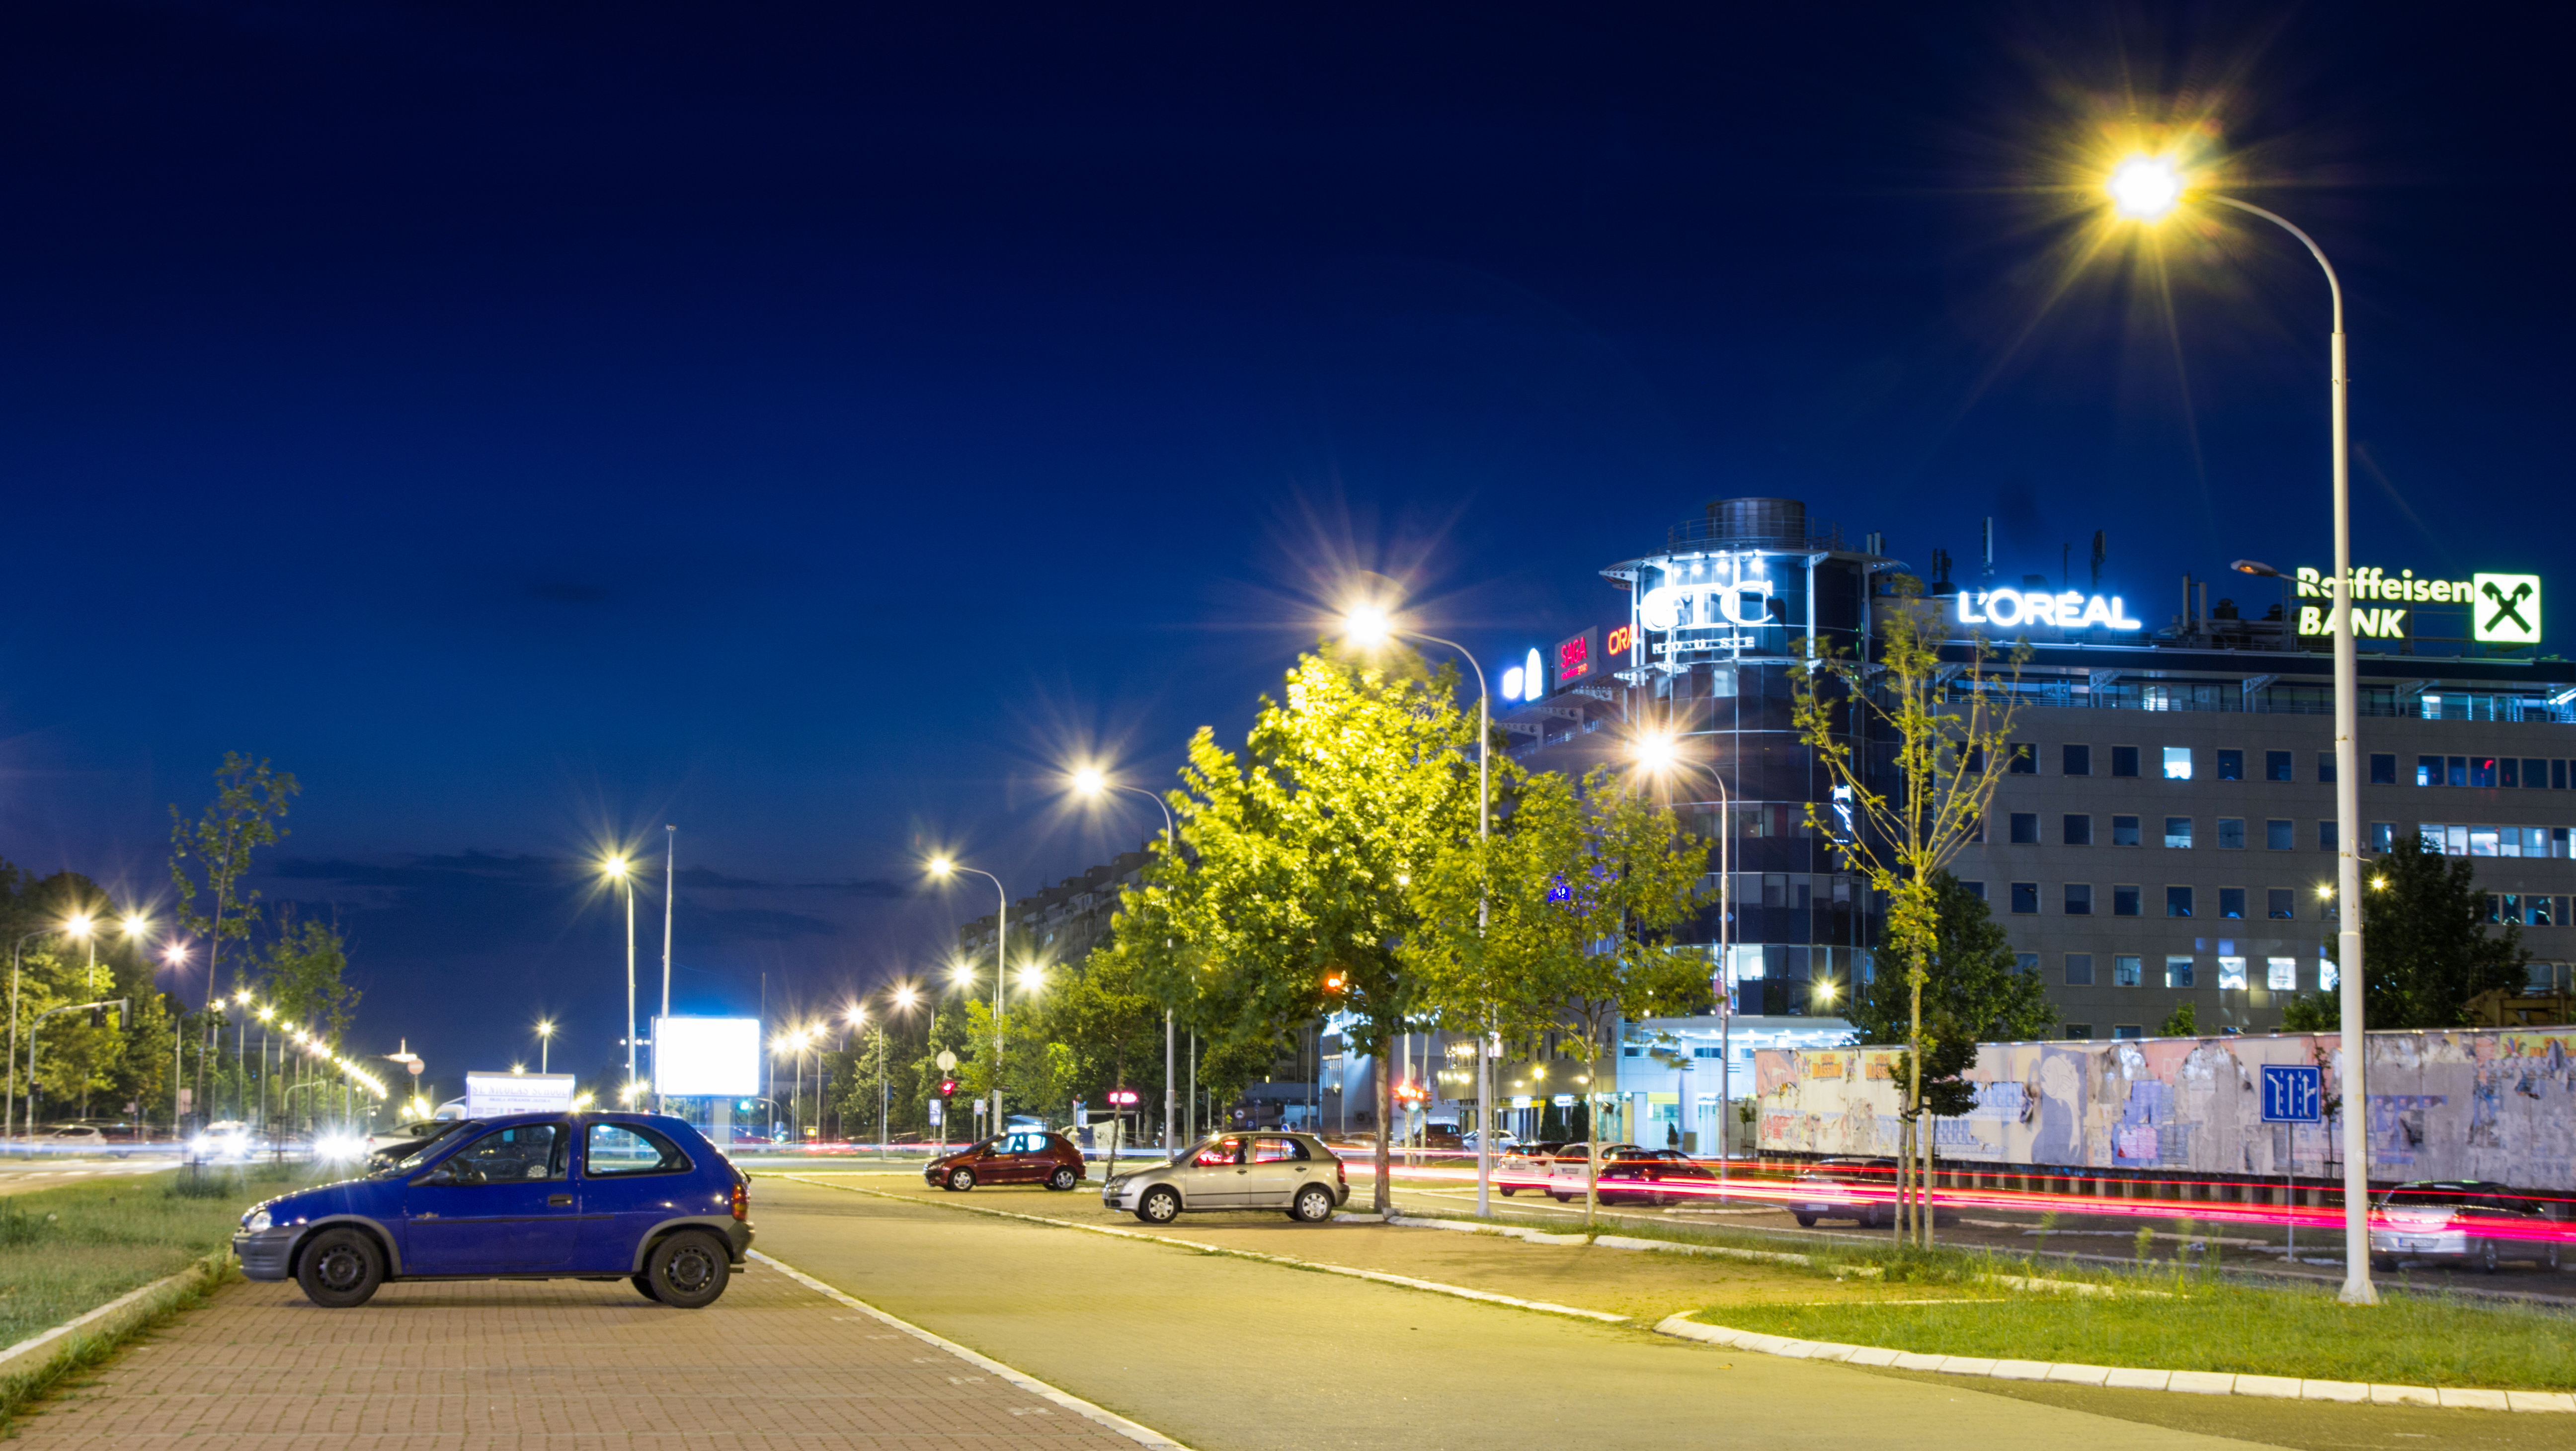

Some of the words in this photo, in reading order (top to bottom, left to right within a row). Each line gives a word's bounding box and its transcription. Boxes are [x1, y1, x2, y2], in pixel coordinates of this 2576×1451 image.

[1639, 580, 1773, 632] GTC
[1959, 589, 2141, 629] L'ORÉAL
[2299, 606, 2407, 638] BANK
[1561, 637, 1587, 668] SAGA
[1652, 637, 1755, 654] HOUSE
[1812, 1062, 1843, 1079] MASSIMO
[931, 1101, 939, 1110] P
